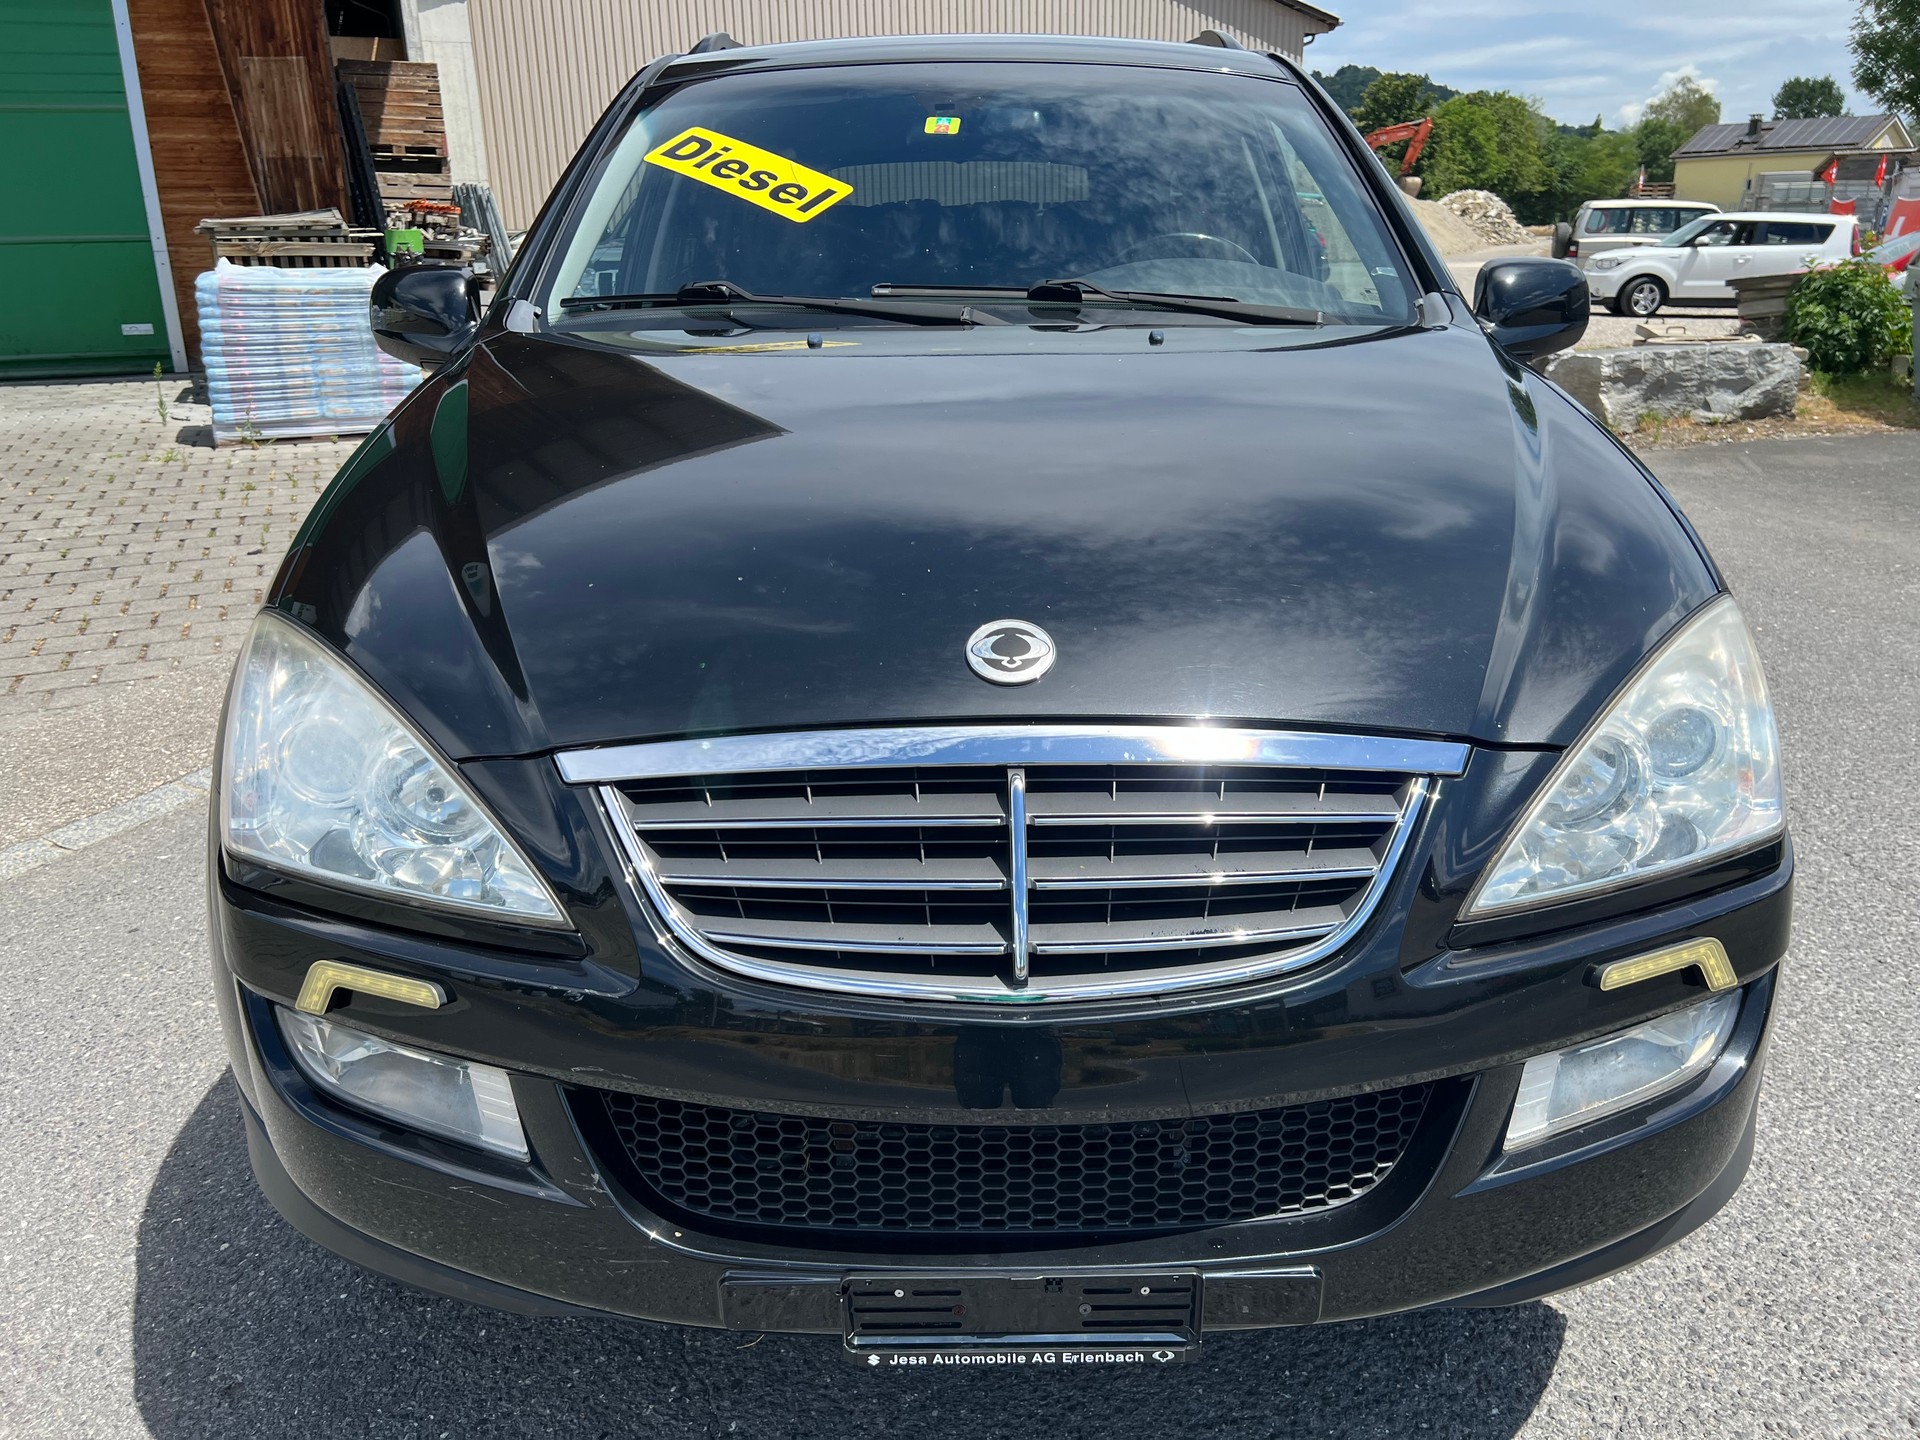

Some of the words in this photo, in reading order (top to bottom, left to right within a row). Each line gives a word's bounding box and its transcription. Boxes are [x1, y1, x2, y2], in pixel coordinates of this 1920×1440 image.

[659, 134, 838, 214] Diesel
[889, 1353, 927, 1366] Jesa
[932, 1352, 1027, 1365] Automobile
[1031, 1352, 1056, 1364] AG
[1062, 1351, 1144, 1364] Erlenbach
